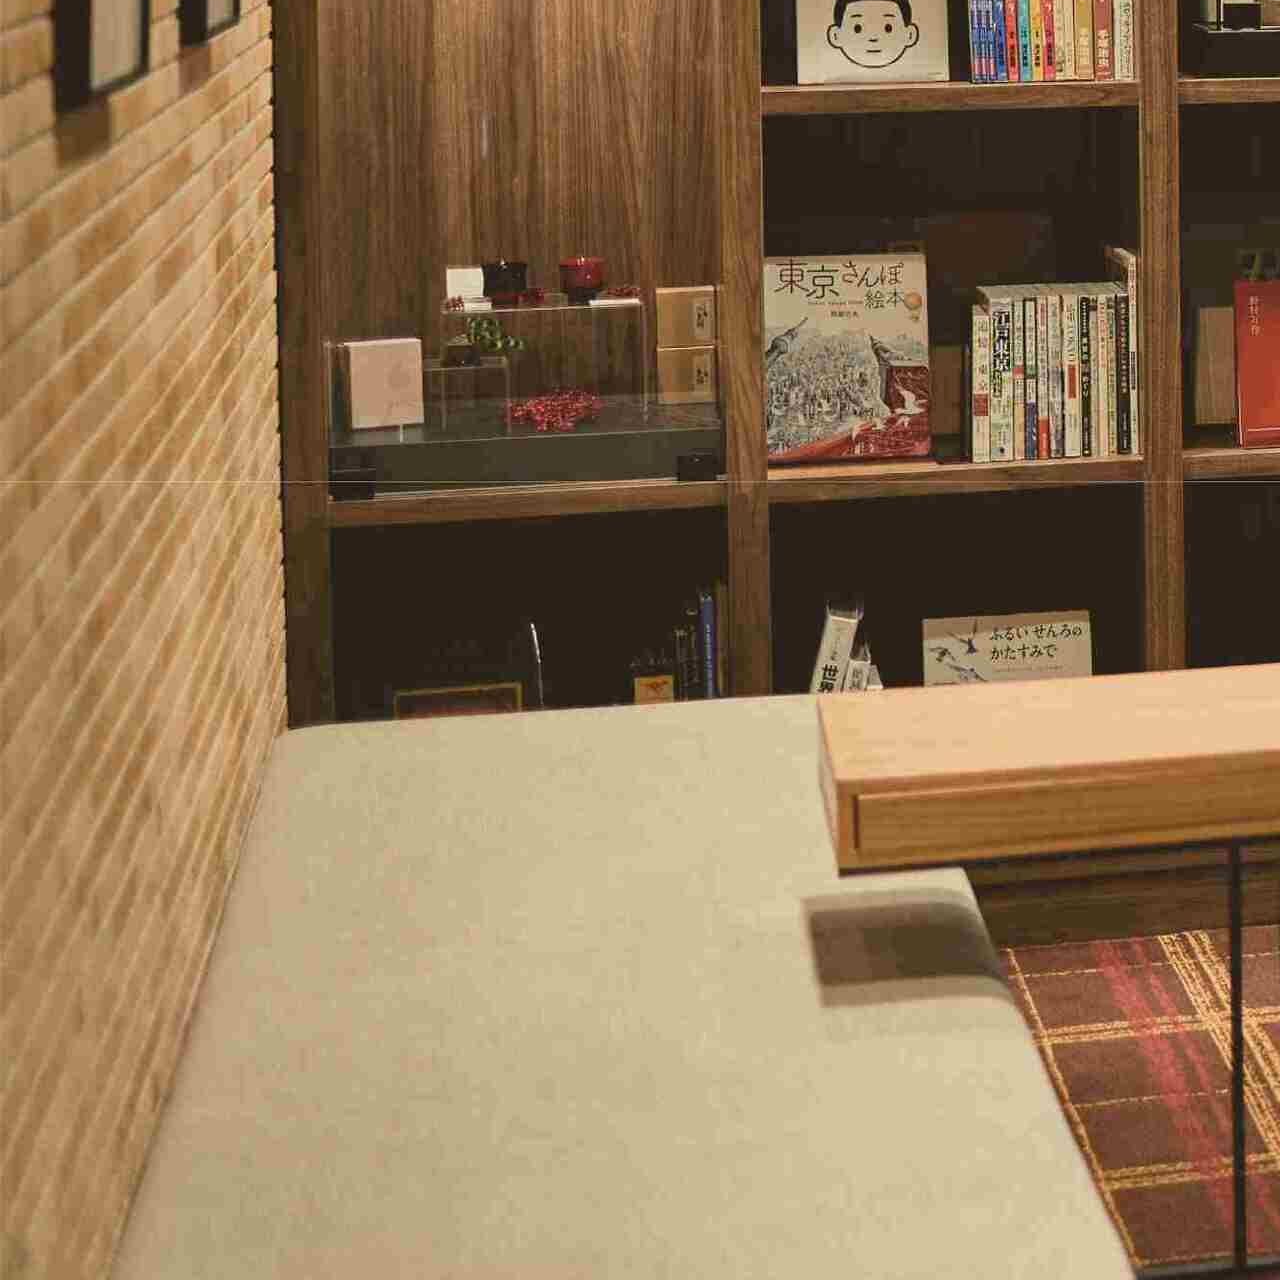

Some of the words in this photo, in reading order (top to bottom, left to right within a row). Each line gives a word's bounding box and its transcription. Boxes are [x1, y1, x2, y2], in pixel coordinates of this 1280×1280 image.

[774, 259, 904, 299] 東京さんぽ
[864, 290, 905, 309] 絵本
[991, 643, 1056, 661] かたすみで
